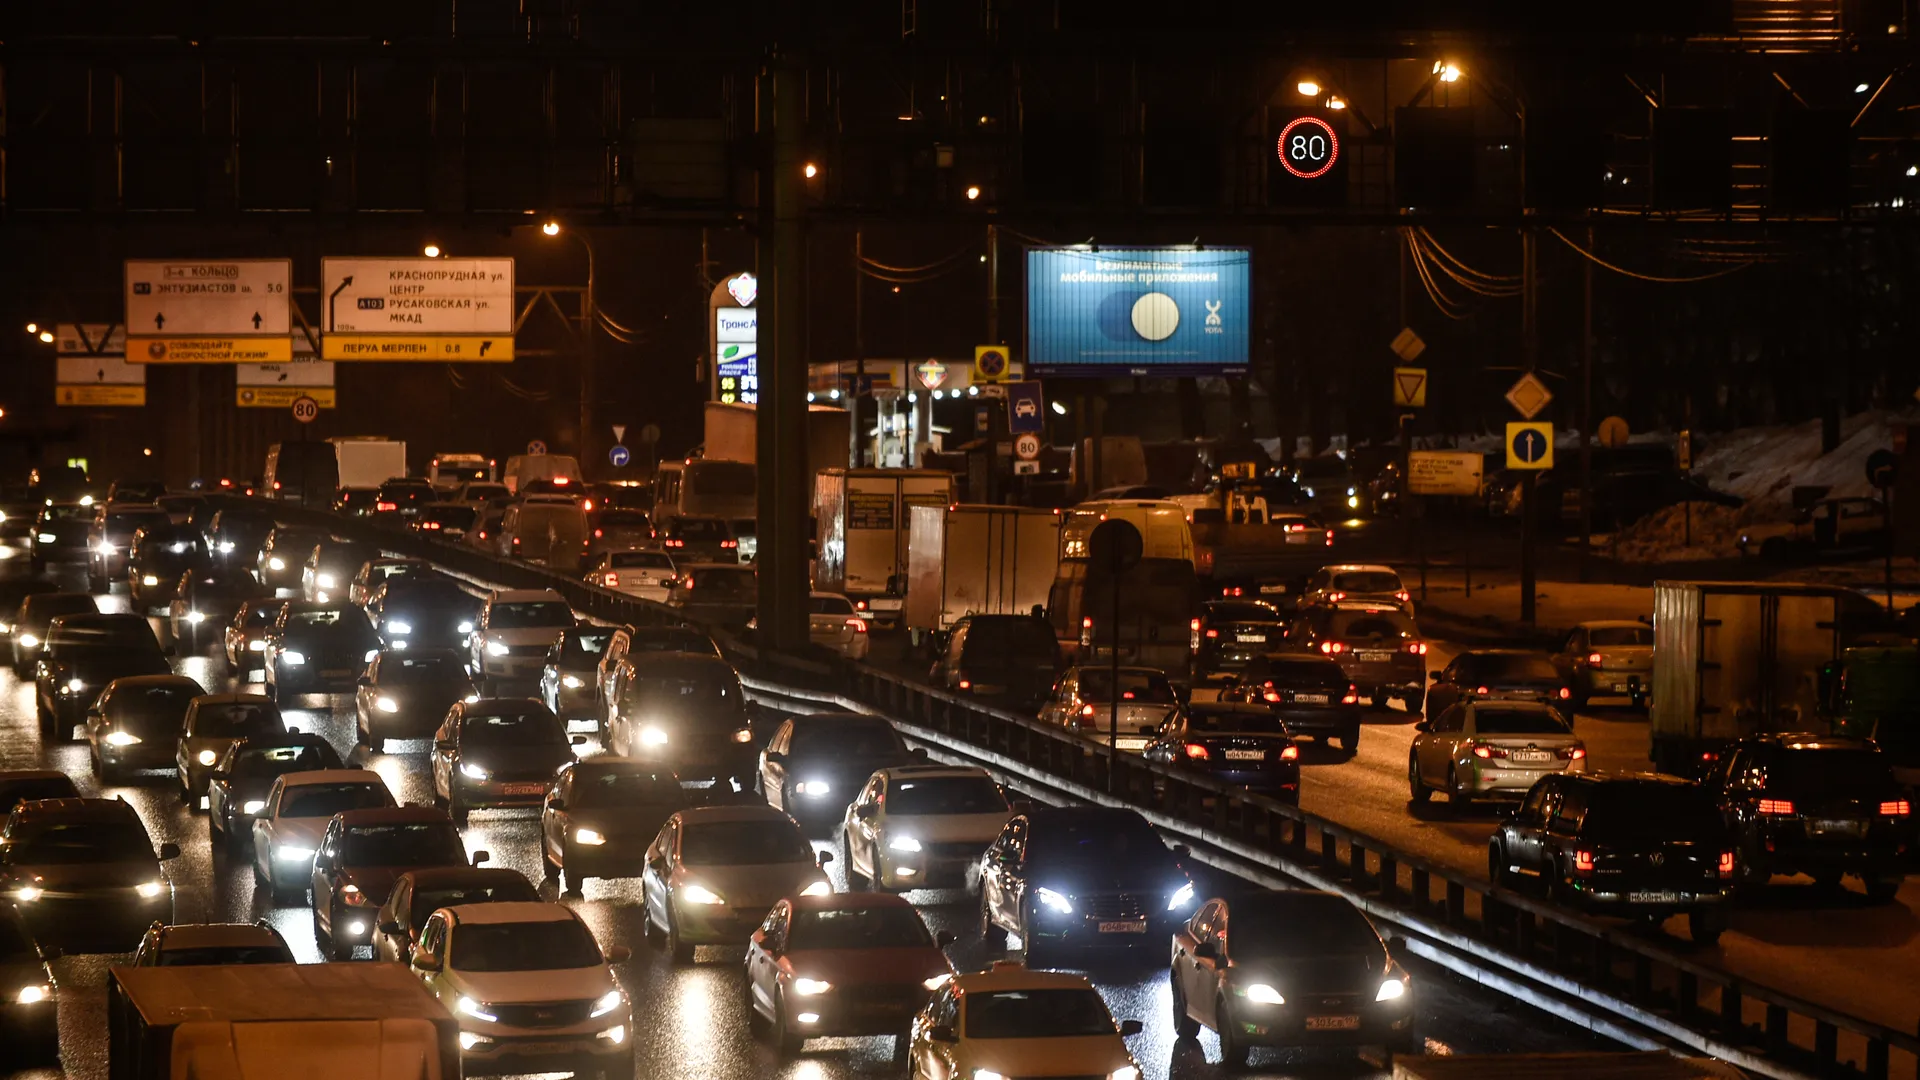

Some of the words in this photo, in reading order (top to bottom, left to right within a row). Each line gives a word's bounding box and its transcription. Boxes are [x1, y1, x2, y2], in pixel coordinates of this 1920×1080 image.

[1291, 135, 1325, 160] 80
[192, 266, 237, 278] КОЛЬЦО
[389, 271, 486, 282] КРАСНОПРУДНАЯ
[490, 273, 505, 283] ул.
[1060, 270, 1136, 283] мобильные
[1138, 271, 1219, 285] приложения
[157, 283, 237, 293] ЭНТУЗИАСТОВ
[267, 284, 283, 293] 5.0
[389, 286, 425, 296] ЦЕНТР
[389, 300, 471, 309] РУСАКОВСКАЯ
[475, 302, 490, 311] ул.
[389, 314, 423, 324] МКАД
[169, 341, 234, 349] СОБЛЮДАЙТЕ
[169, 351, 231, 360] СКОРОСТНОЙ
[295, 403, 314, 417] 80
[1020, 442, 1035, 453] 80
